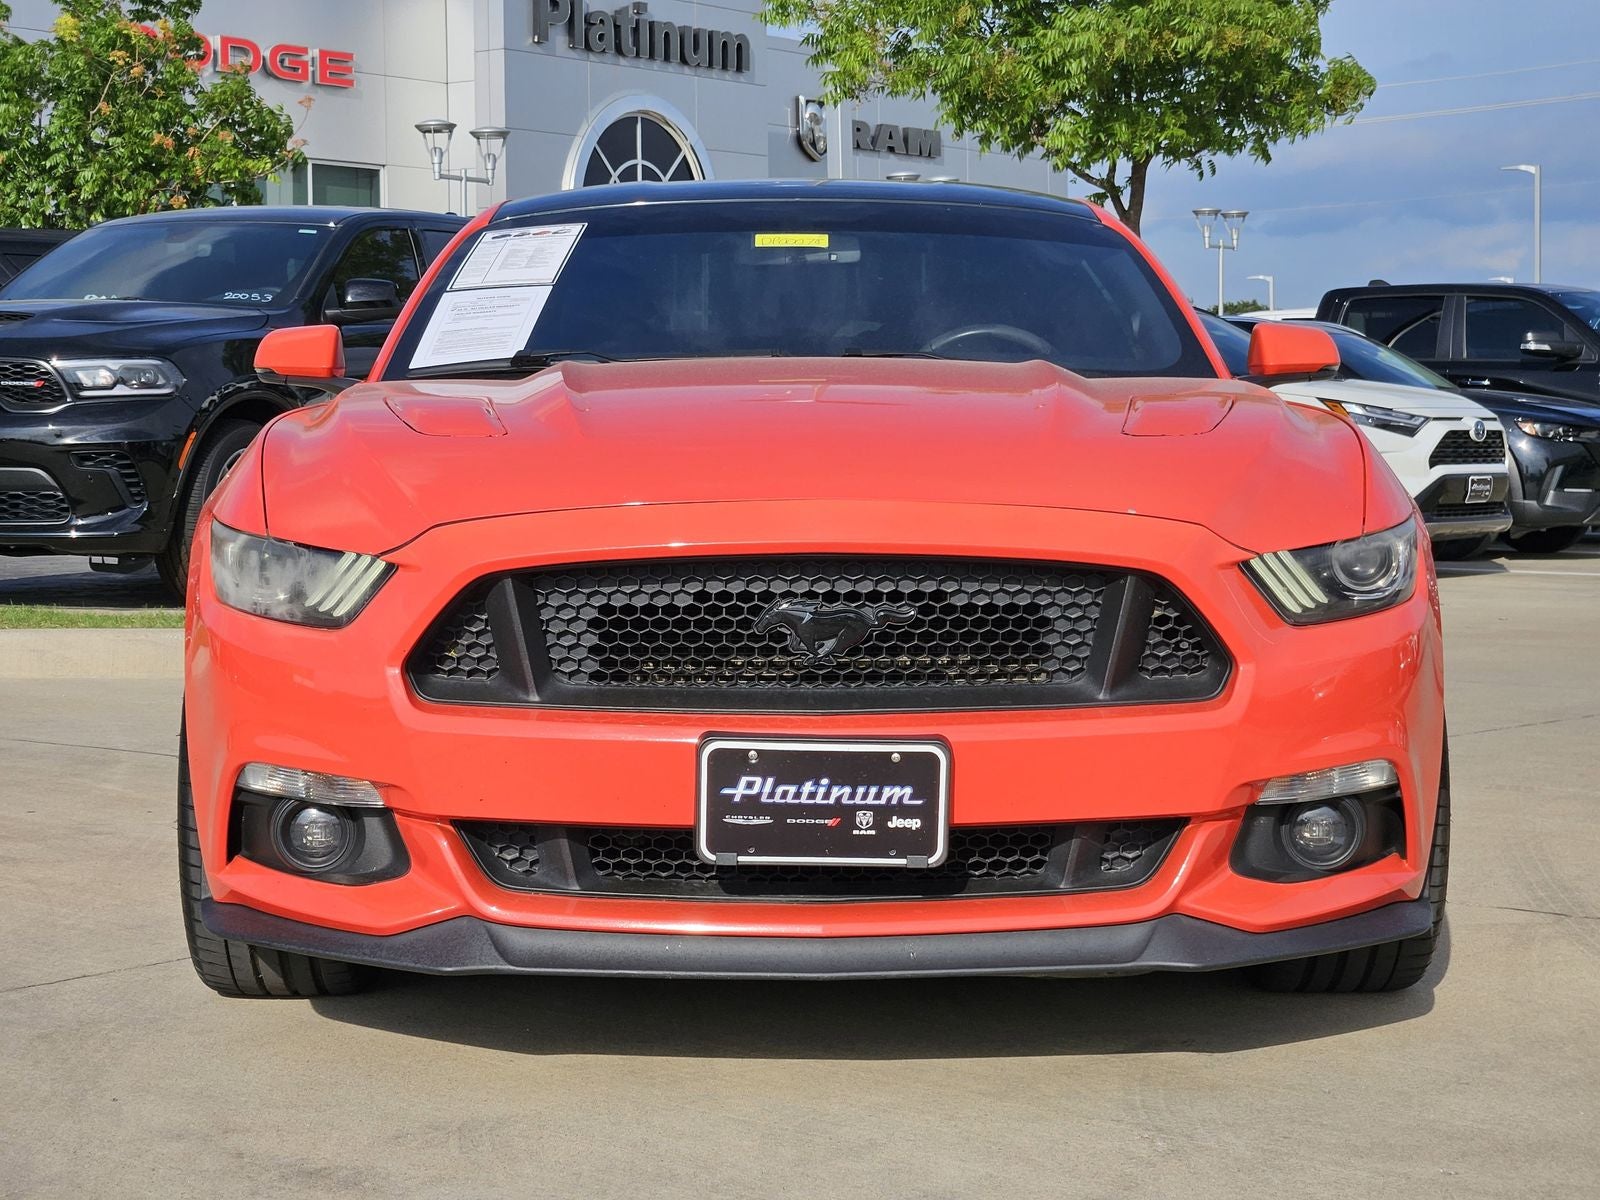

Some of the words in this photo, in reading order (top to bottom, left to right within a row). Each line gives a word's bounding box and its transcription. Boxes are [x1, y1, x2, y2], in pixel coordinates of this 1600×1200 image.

[532, 0, 750, 73] Platinum
[852, 119, 941, 157] RAM
[223, 292, 273, 303] 20053
[720, 776, 926, 805] Platinum
[887, 816, 921, 830] Jeep
